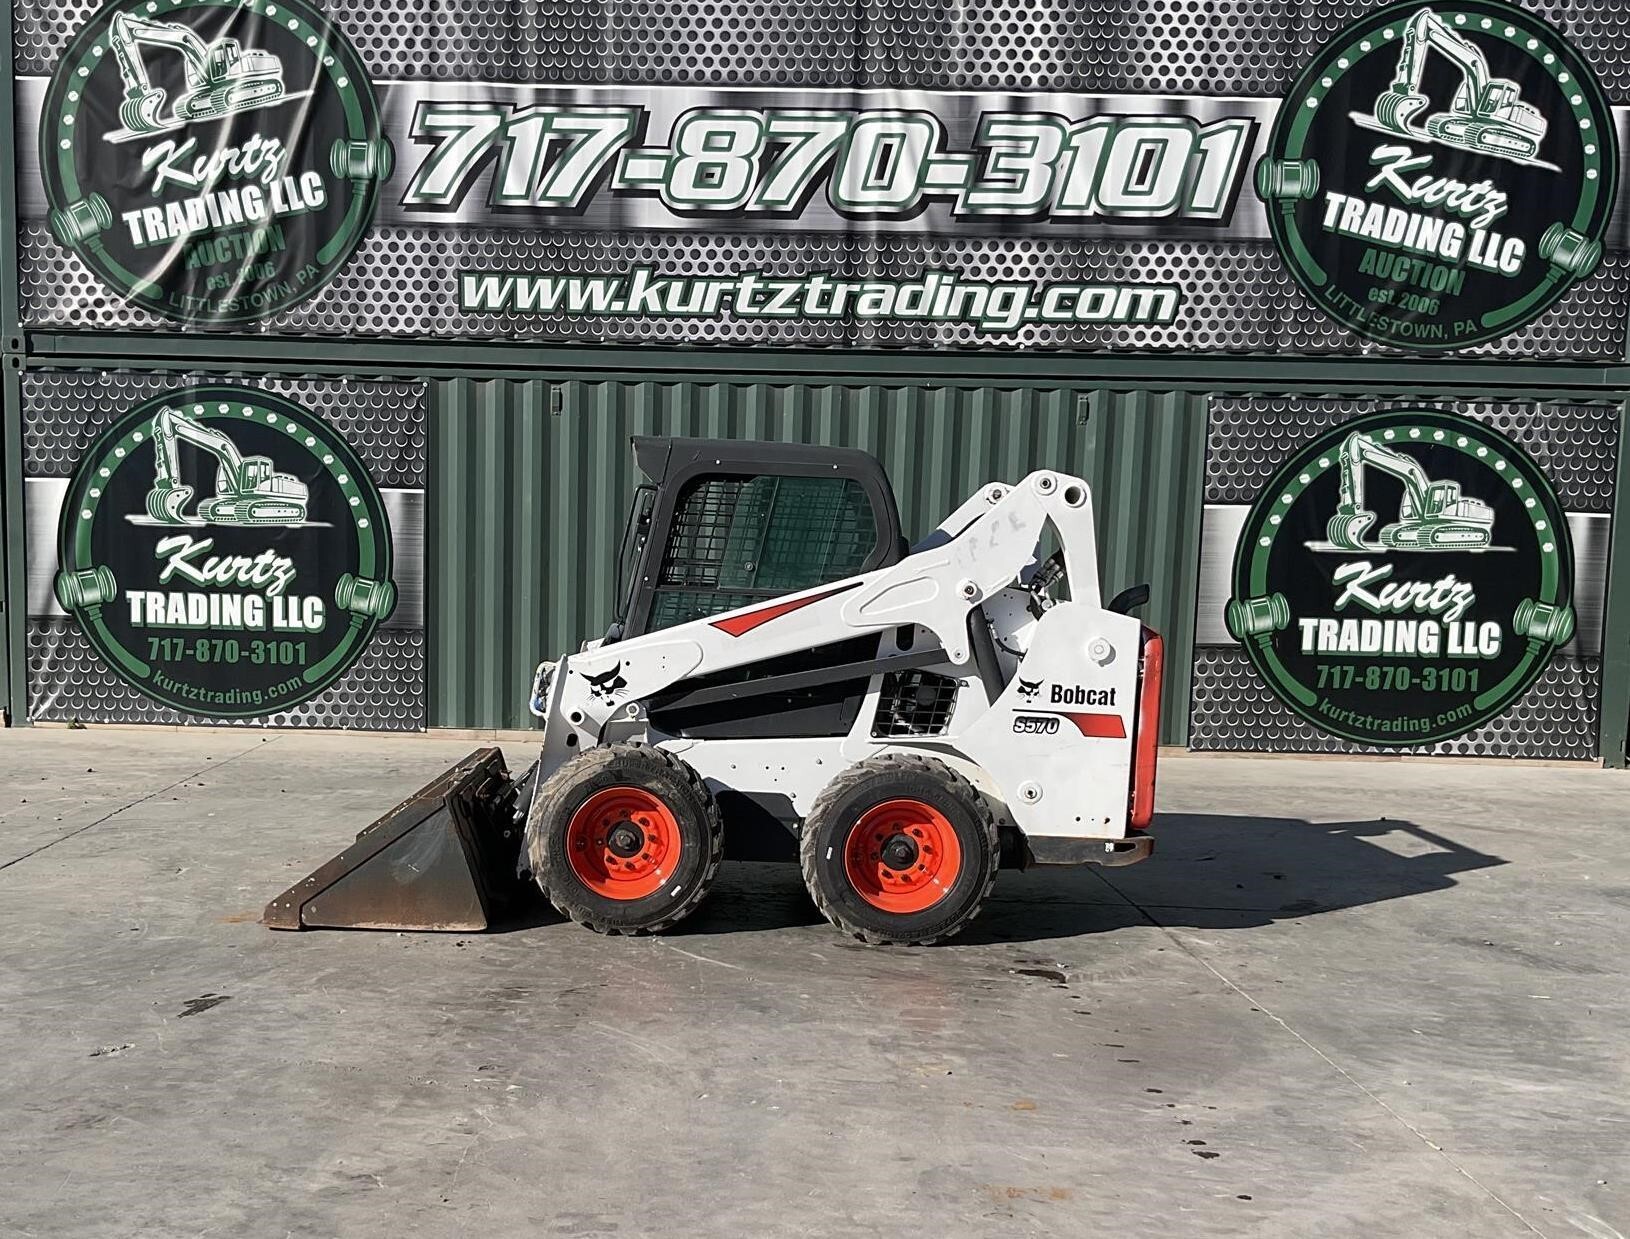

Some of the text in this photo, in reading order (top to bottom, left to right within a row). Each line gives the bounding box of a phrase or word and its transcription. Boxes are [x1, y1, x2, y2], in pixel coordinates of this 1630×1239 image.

[142, 133, 288, 196] Kurtz
[401, 100, 1259, 227] 717-870-3101
[122, 171, 327, 247] TRADING LLC
[1365, 144, 1508, 232] Kurtz
[1322, 191, 1526, 277] TRADING LLC
[296, 263, 319, 285] PA
[1358, 248, 1466, 296] AUCTION
[459, 263, 1181, 334] www.kurtztrading.com
[1397, 292, 1440, 316] 2006
[1453, 319, 1478, 336] PA
[155, 534, 297, 598] Kurtz
[125, 590, 326, 633] TRADING LLC
[1332, 561, 1476, 627] Kurtz
[147, 637, 306, 665] 717-870-3101
[1298, 618, 1503, 660] TRADING LLC
[152, 670, 303, 705] kurtztrading.com
[1050, 684, 1116, 706] Bobcat
[1316, 665, 1479, 692] 717-870-3101
[1012, 715, 1060, 735] S570
[1319, 697, 1473, 733] kurtztrading.com
